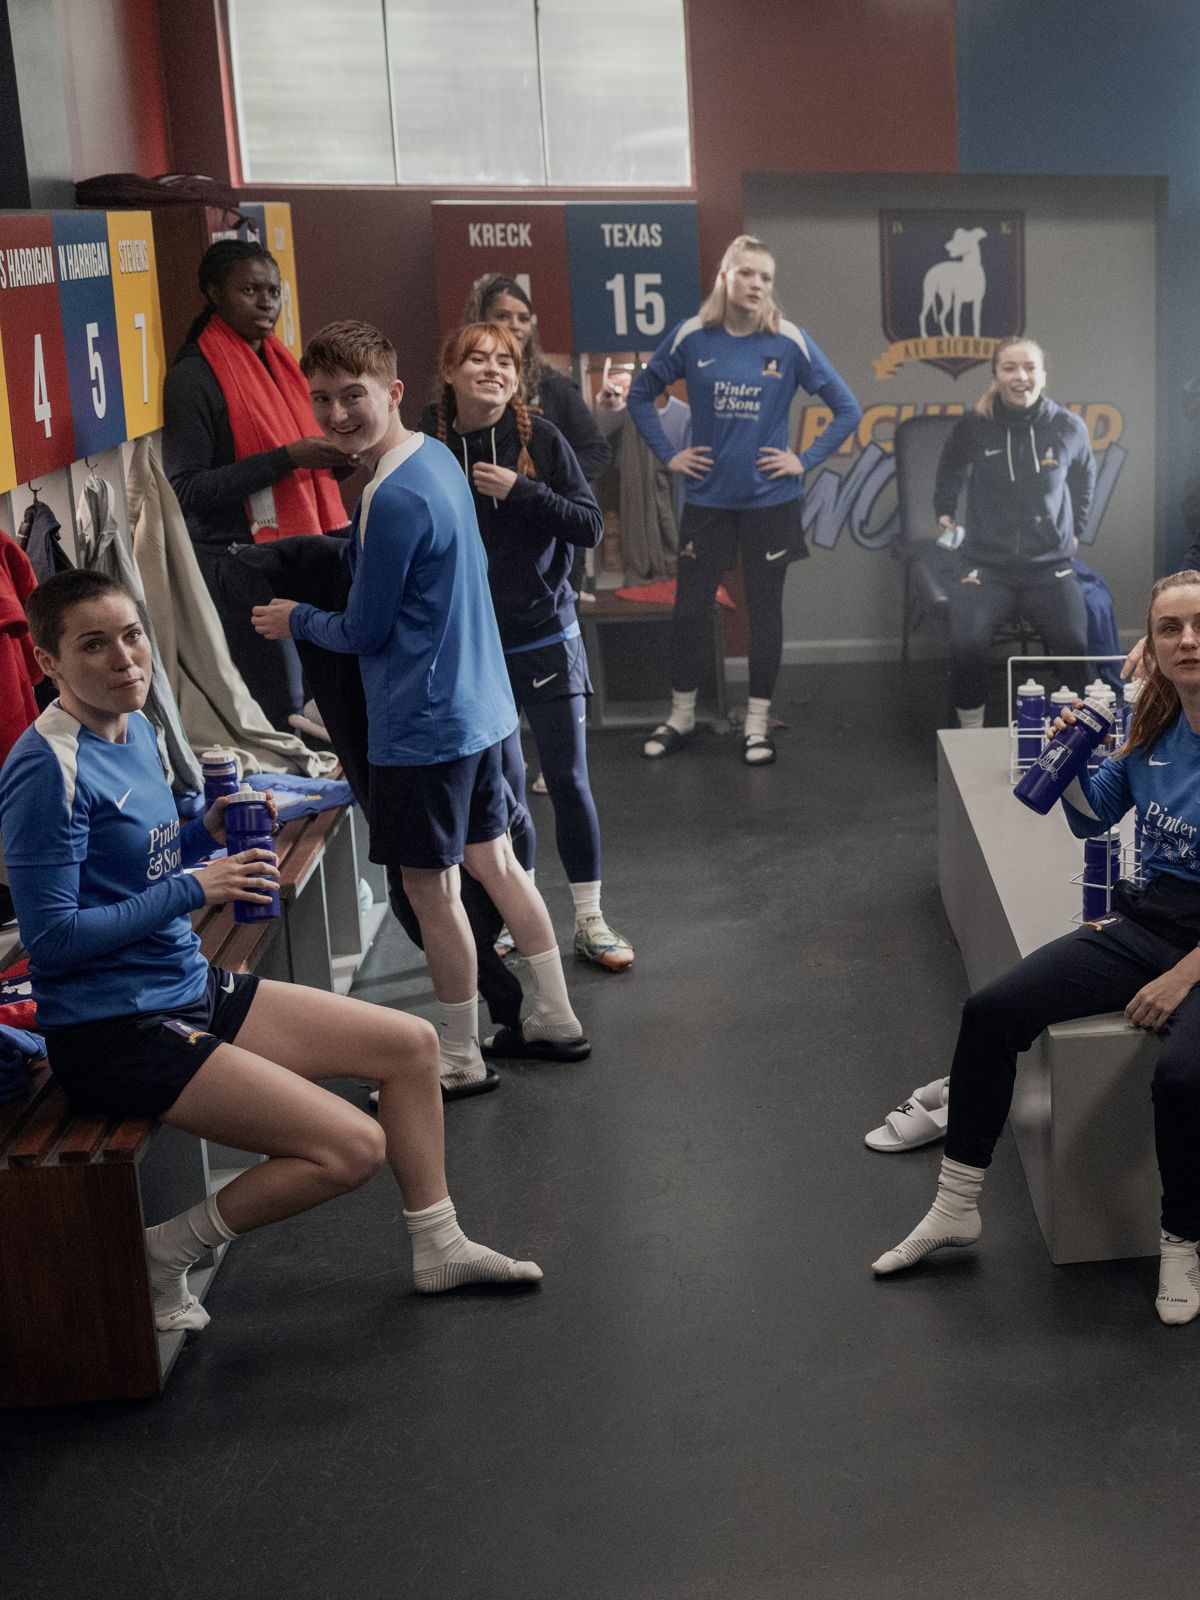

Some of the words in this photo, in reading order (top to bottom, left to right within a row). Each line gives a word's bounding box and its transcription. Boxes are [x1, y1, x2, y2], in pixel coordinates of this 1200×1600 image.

[468, 223, 532, 248] KRECK
[601, 223, 663, 248] TEXAS
[6, 246, 55, 288] HARRIGAN
[58, 245, 68, 281] N
[66, 242, 109, 280] HARRIGAN
[118, 239, 149, 275] STEVENS
[605, 272, 666, 336] 15
[33, 333, 53, 438] 4
[86, 322, 107, 419] 5
[714, 381, 762, 397] Pinter
[147, 818, 181, 855] Pinte
[1144, 800, 1198, 839] Pinter
